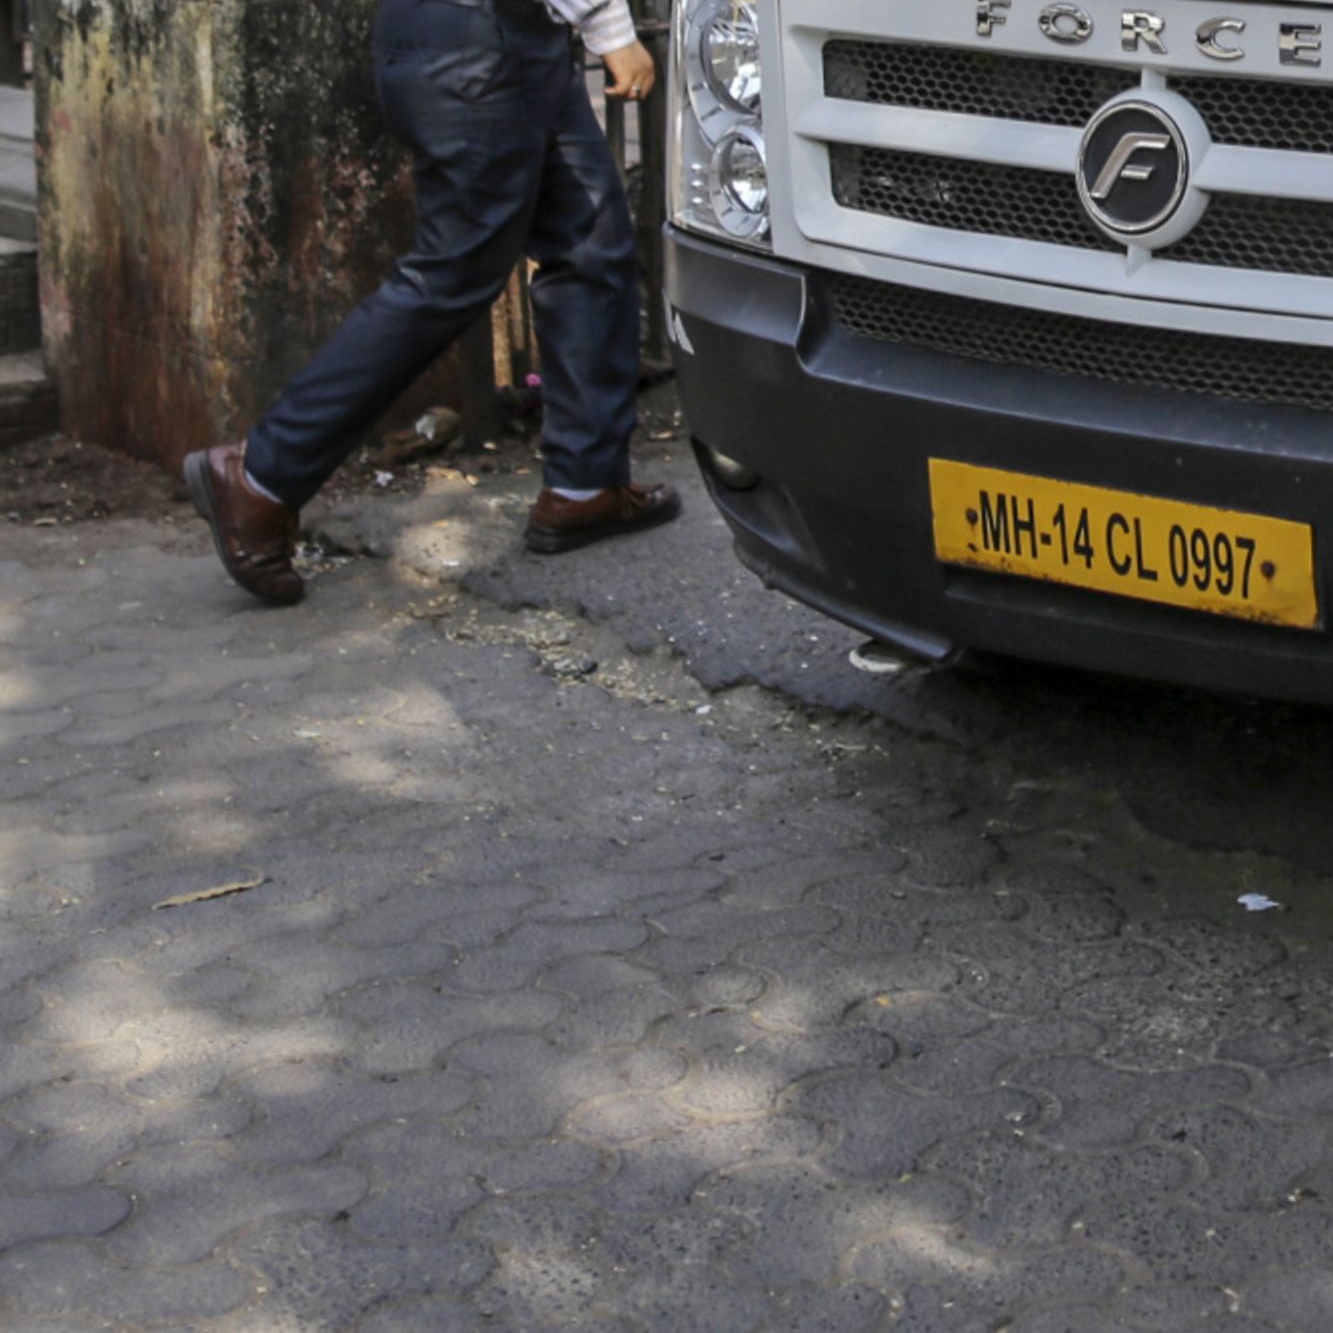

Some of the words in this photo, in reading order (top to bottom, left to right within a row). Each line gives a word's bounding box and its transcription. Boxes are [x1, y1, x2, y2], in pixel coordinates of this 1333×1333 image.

[979, 489, 1095, 570] MH-14
[1105, 512, 1158, 582] CL
[1168, 523, 1256, 599] 0997
